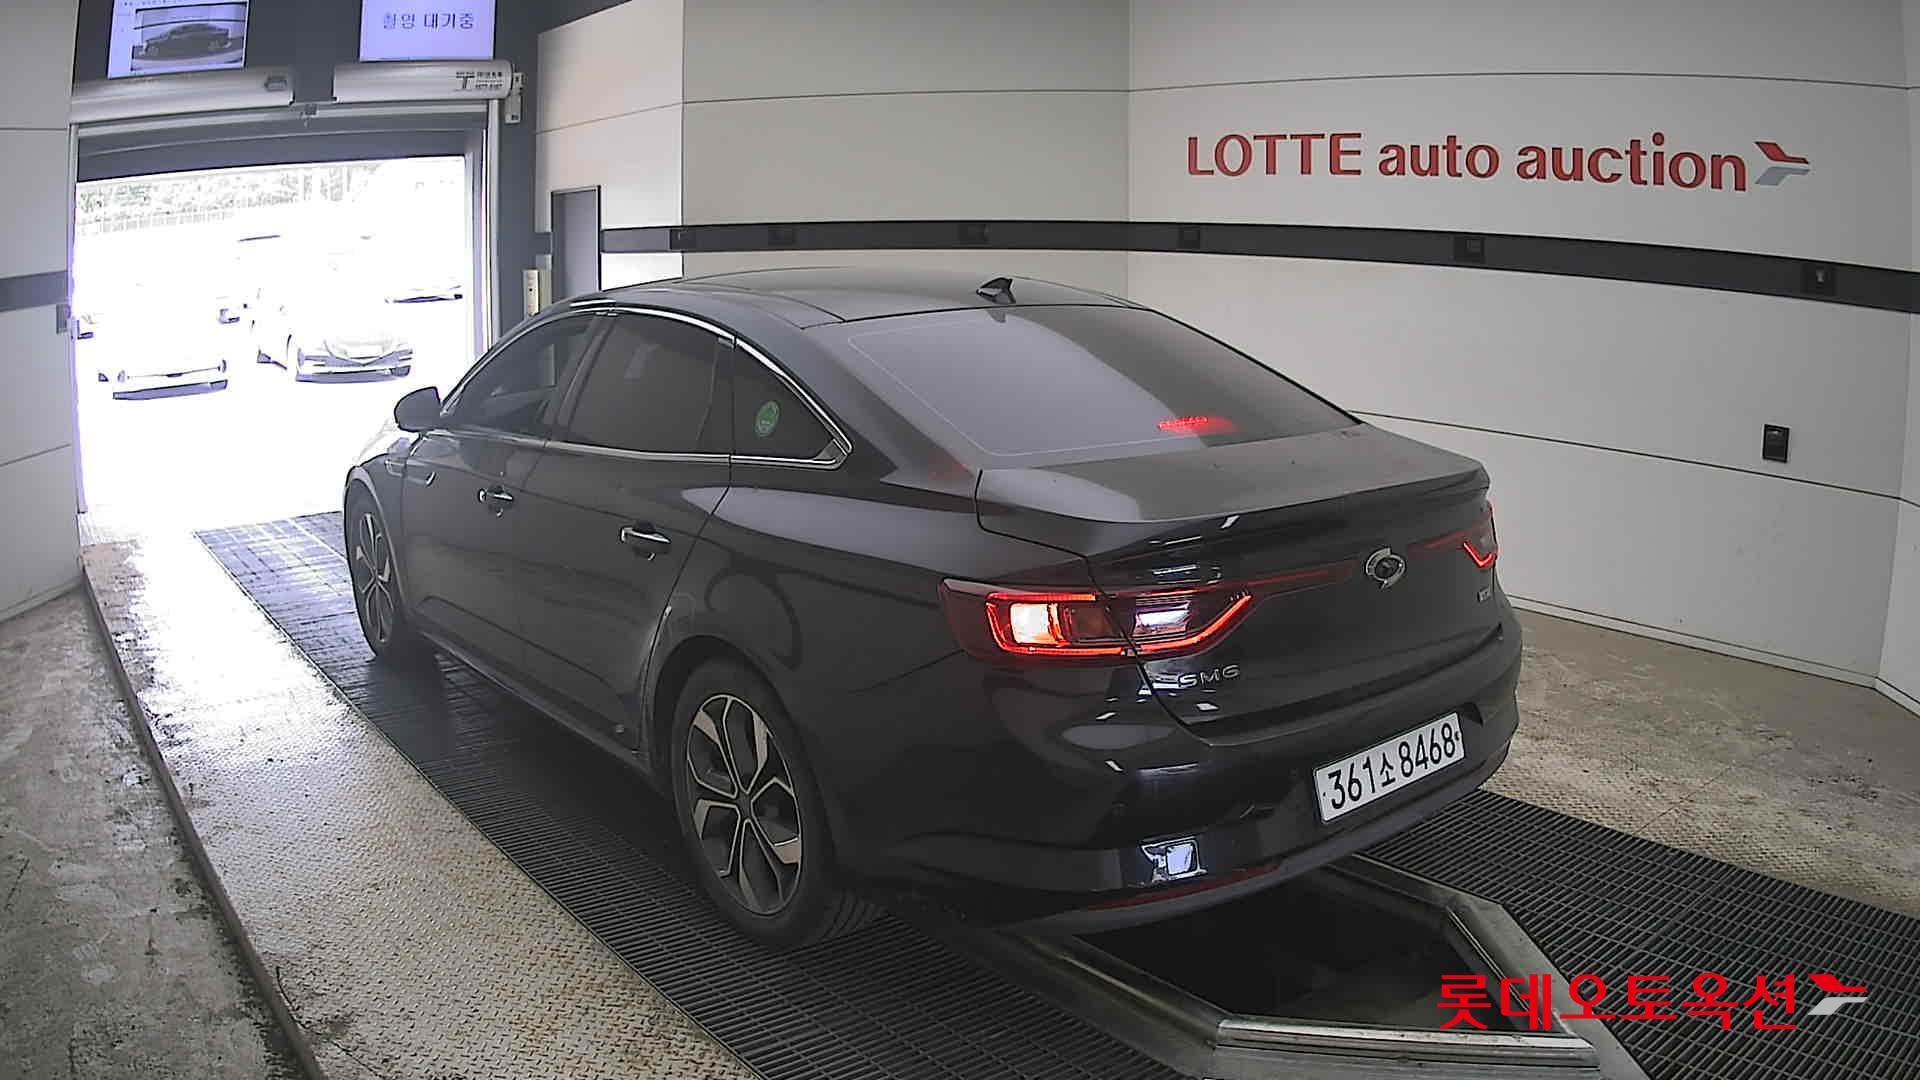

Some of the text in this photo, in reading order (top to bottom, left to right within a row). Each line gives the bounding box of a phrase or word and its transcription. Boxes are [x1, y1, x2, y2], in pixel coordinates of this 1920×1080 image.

[423, 13, 473, 29] 대기중
[1188, 131, 1747, 191] LOTTE auto auction
[1179, 664, 1240, 687] SM6
[1328, 722, 1456, 810] 361소8468
